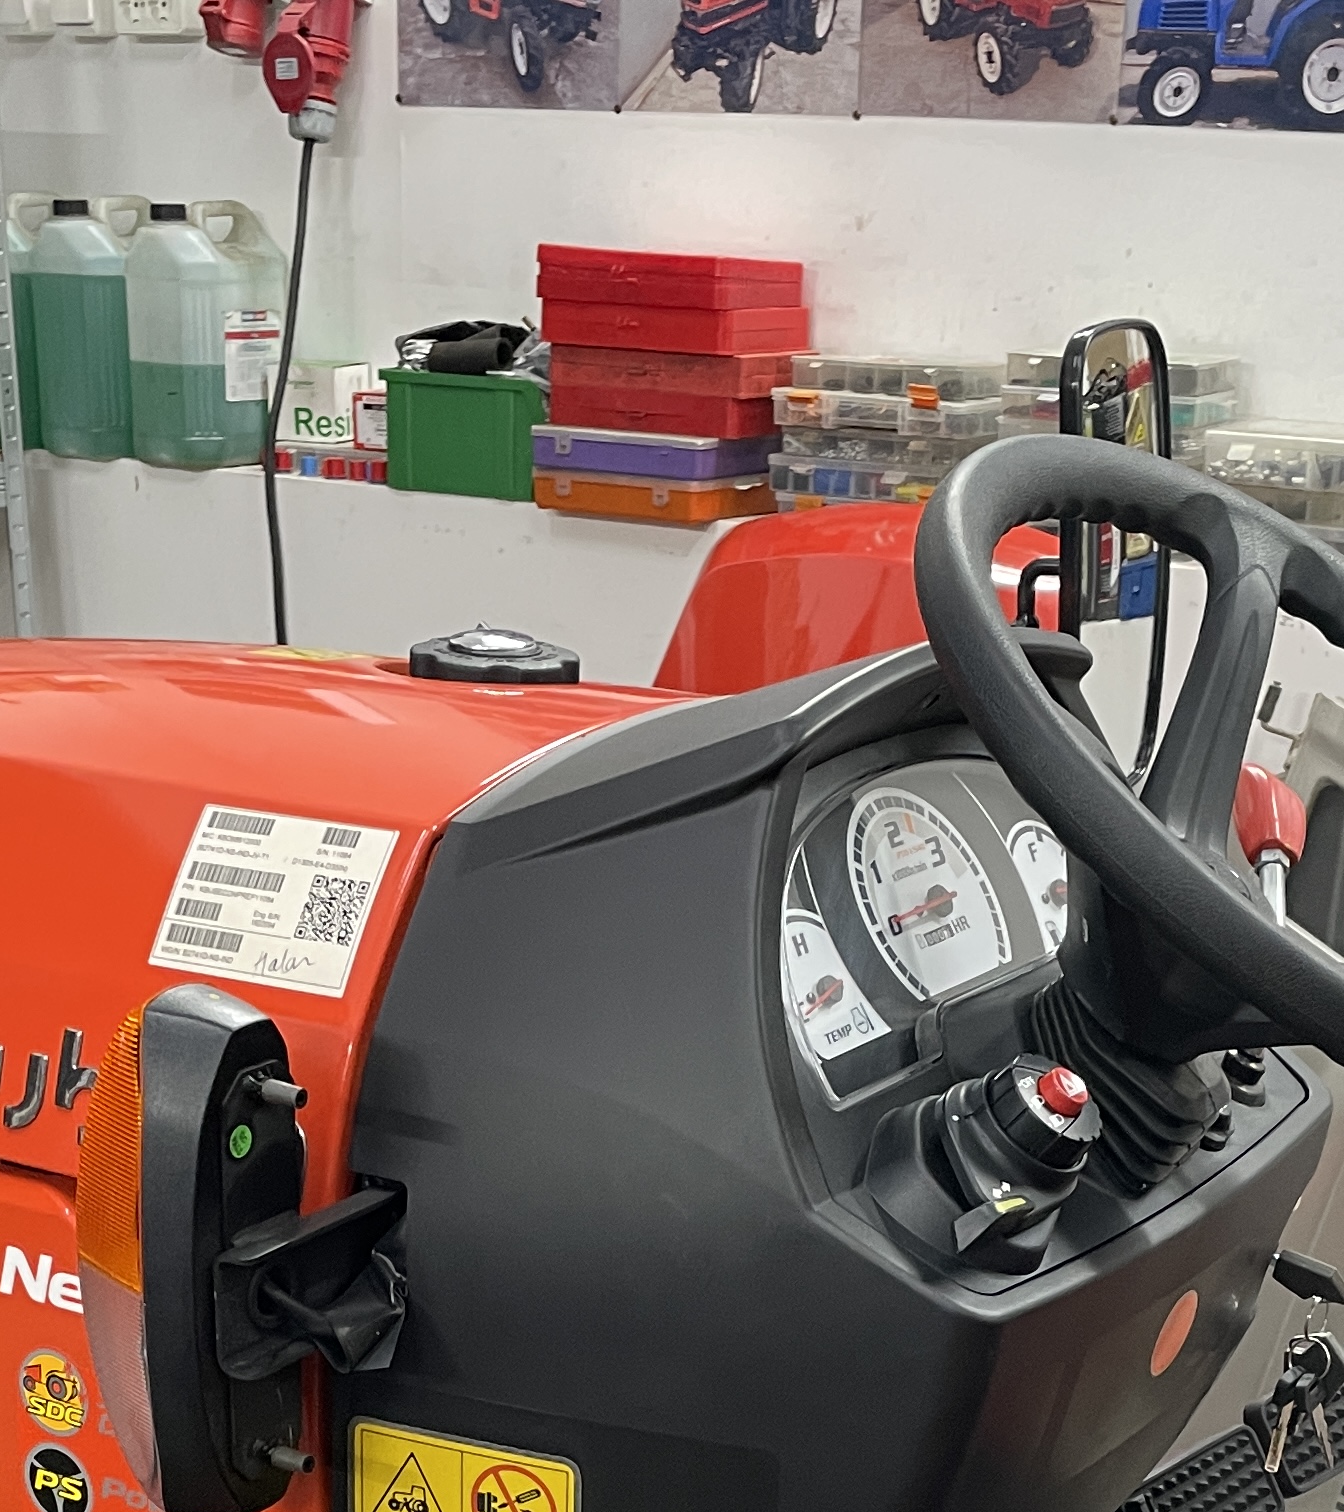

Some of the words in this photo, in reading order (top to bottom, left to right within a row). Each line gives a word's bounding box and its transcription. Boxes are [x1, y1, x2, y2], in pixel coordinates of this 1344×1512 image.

[883, 821, 905, 849] 2
[924, 834, 946, 868] 3
[1027, 841, 1038, 863] F
[869, 859, 883, 884] 1
[791, 932, 810, 957] H
[823, 1022, 853, 1046] TEMP
[26, 1394, 86, 1430] SDC
[33, 1467, 84, 1502] PS
